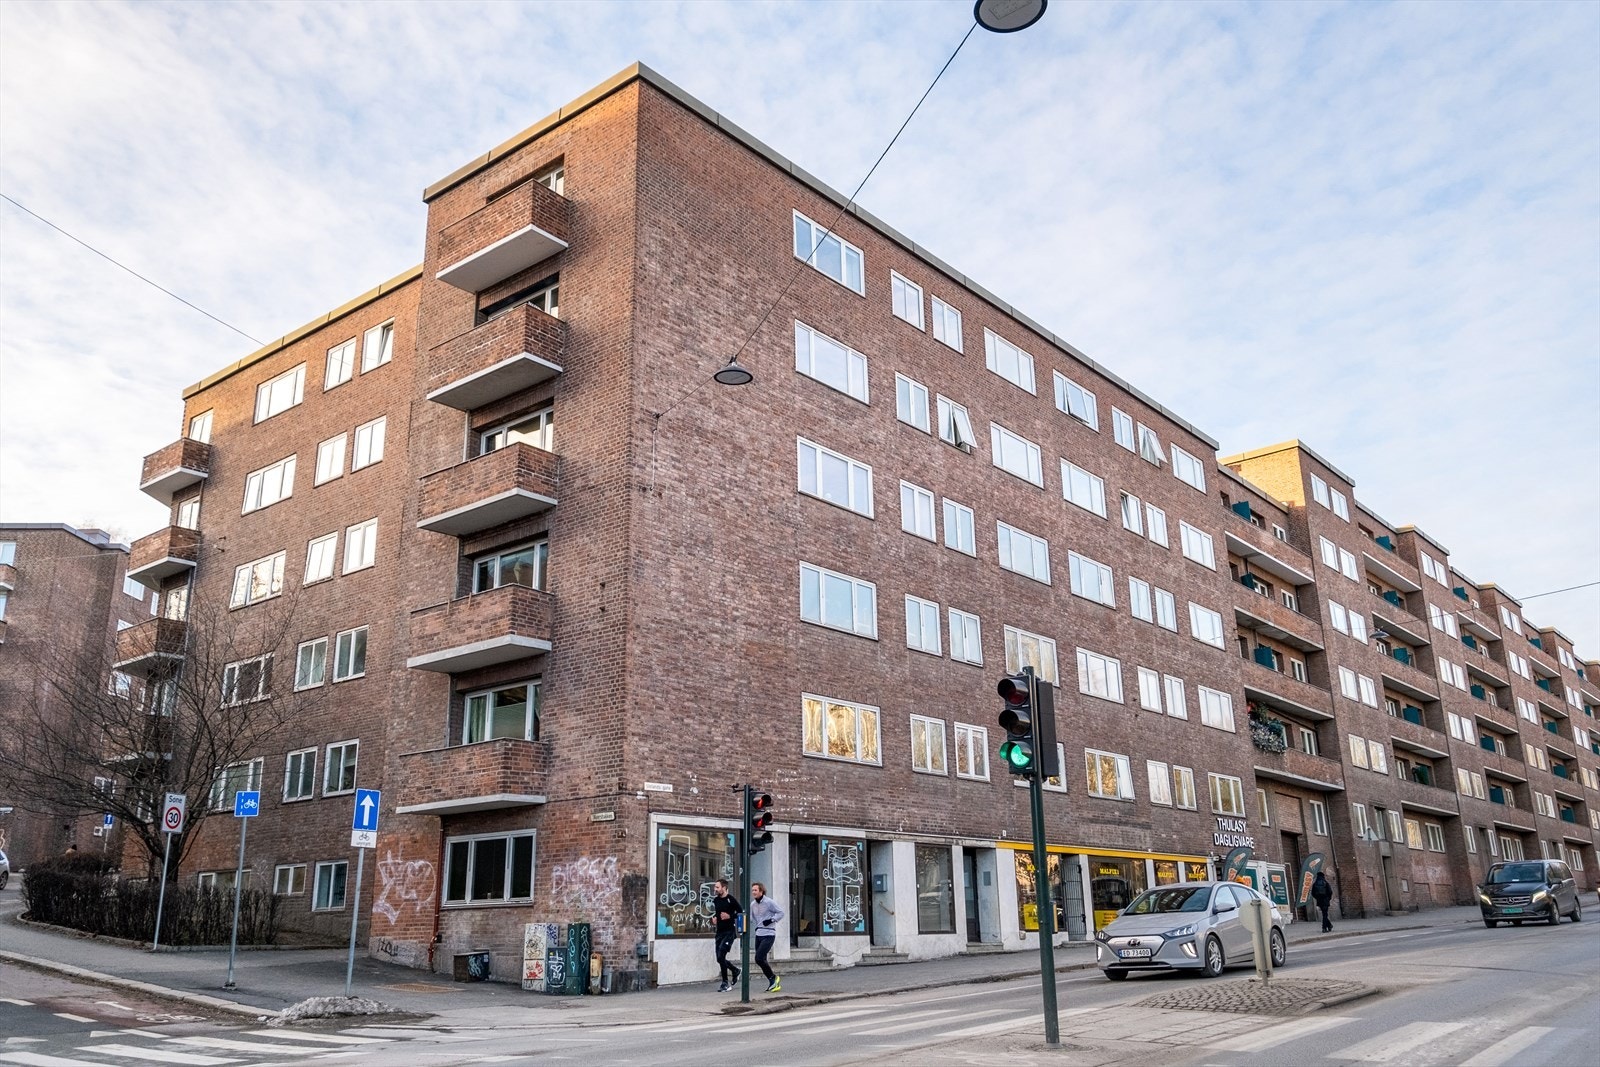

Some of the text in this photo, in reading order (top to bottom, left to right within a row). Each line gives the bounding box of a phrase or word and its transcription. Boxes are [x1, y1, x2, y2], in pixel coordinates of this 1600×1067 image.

[169, 795, 183, 803] Sone
[168, 812, 179, 824] 30
[1216, 817, 1247, 833] THULASY
[1214, 833, 1255, 848] DAGLIGVARE
